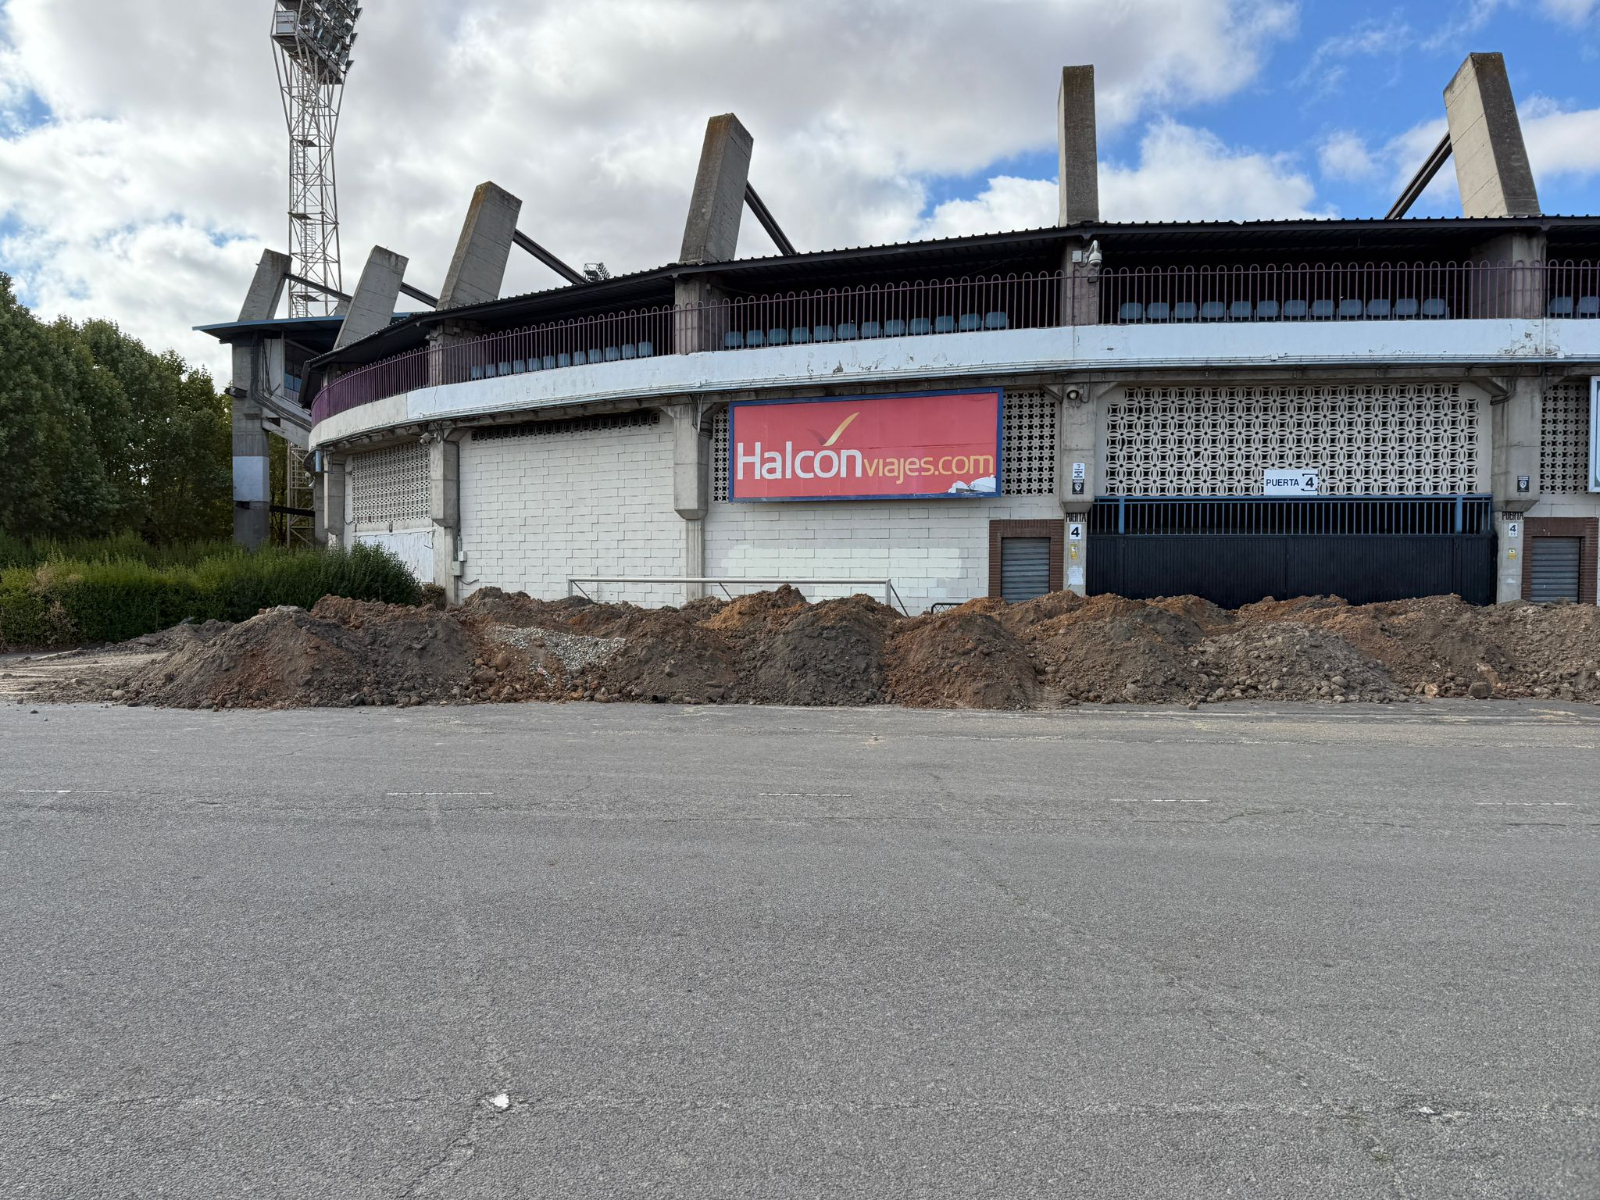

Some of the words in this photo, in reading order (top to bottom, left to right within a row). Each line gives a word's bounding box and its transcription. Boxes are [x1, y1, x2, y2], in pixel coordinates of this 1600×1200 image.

[863, 455, 994, 485] viajes.com
[1266, 478, 1300, 487] PUERTA
[1305, 476, 1315, 488] 4
[1065, 512, 1087, 522] PUERTA
[1071, 526, 1080, 537] 4
